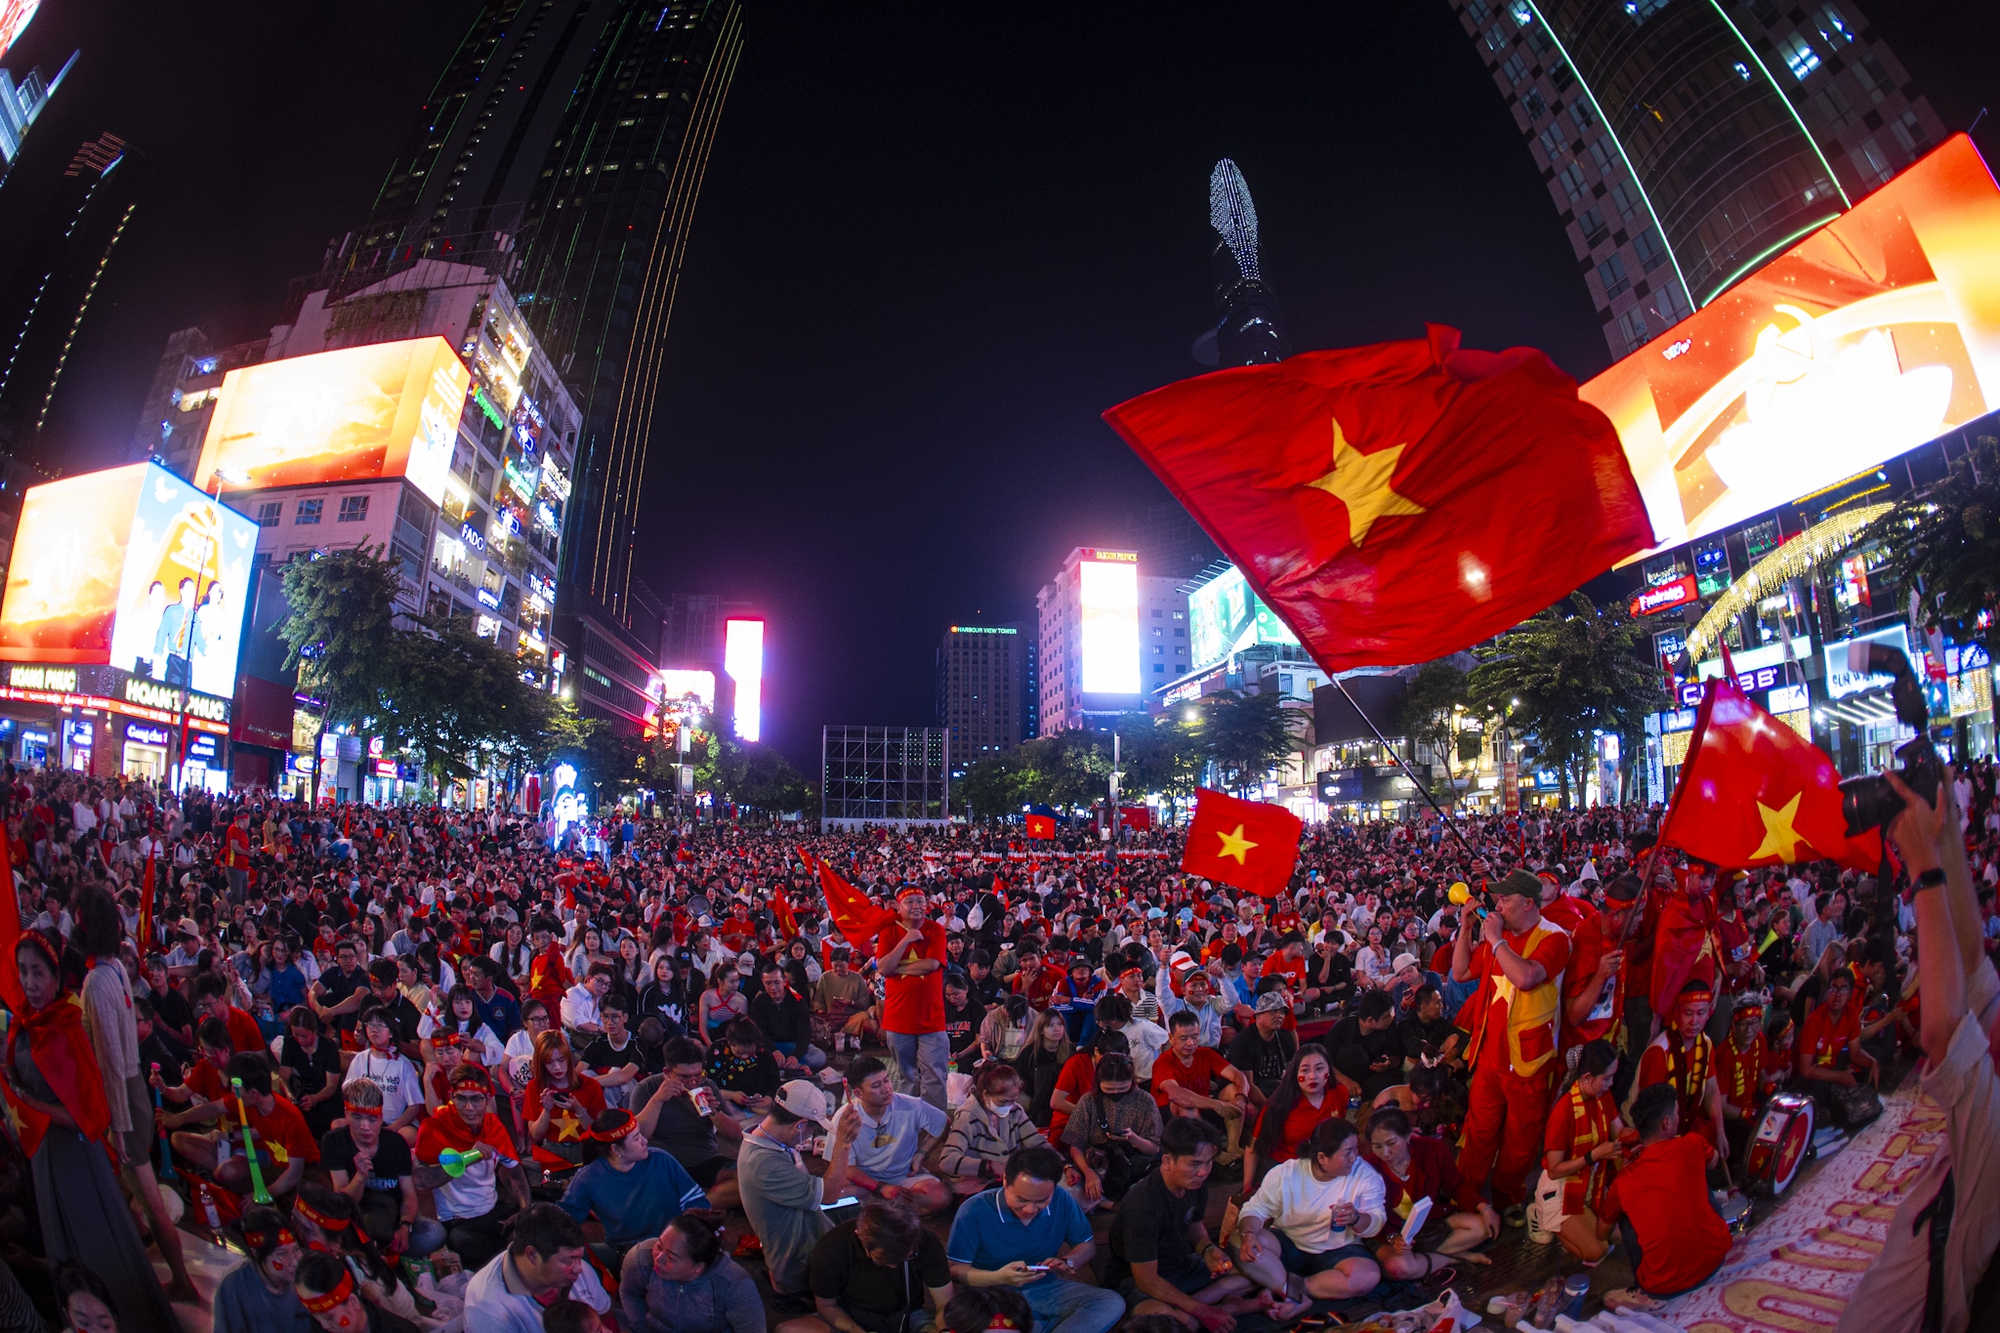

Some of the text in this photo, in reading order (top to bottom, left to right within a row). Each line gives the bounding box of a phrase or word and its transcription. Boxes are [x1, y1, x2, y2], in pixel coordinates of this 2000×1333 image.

[1096, 551, 1138, 562] SAIGON PRINCE
[530, 573, 556, 604] THE ONE
